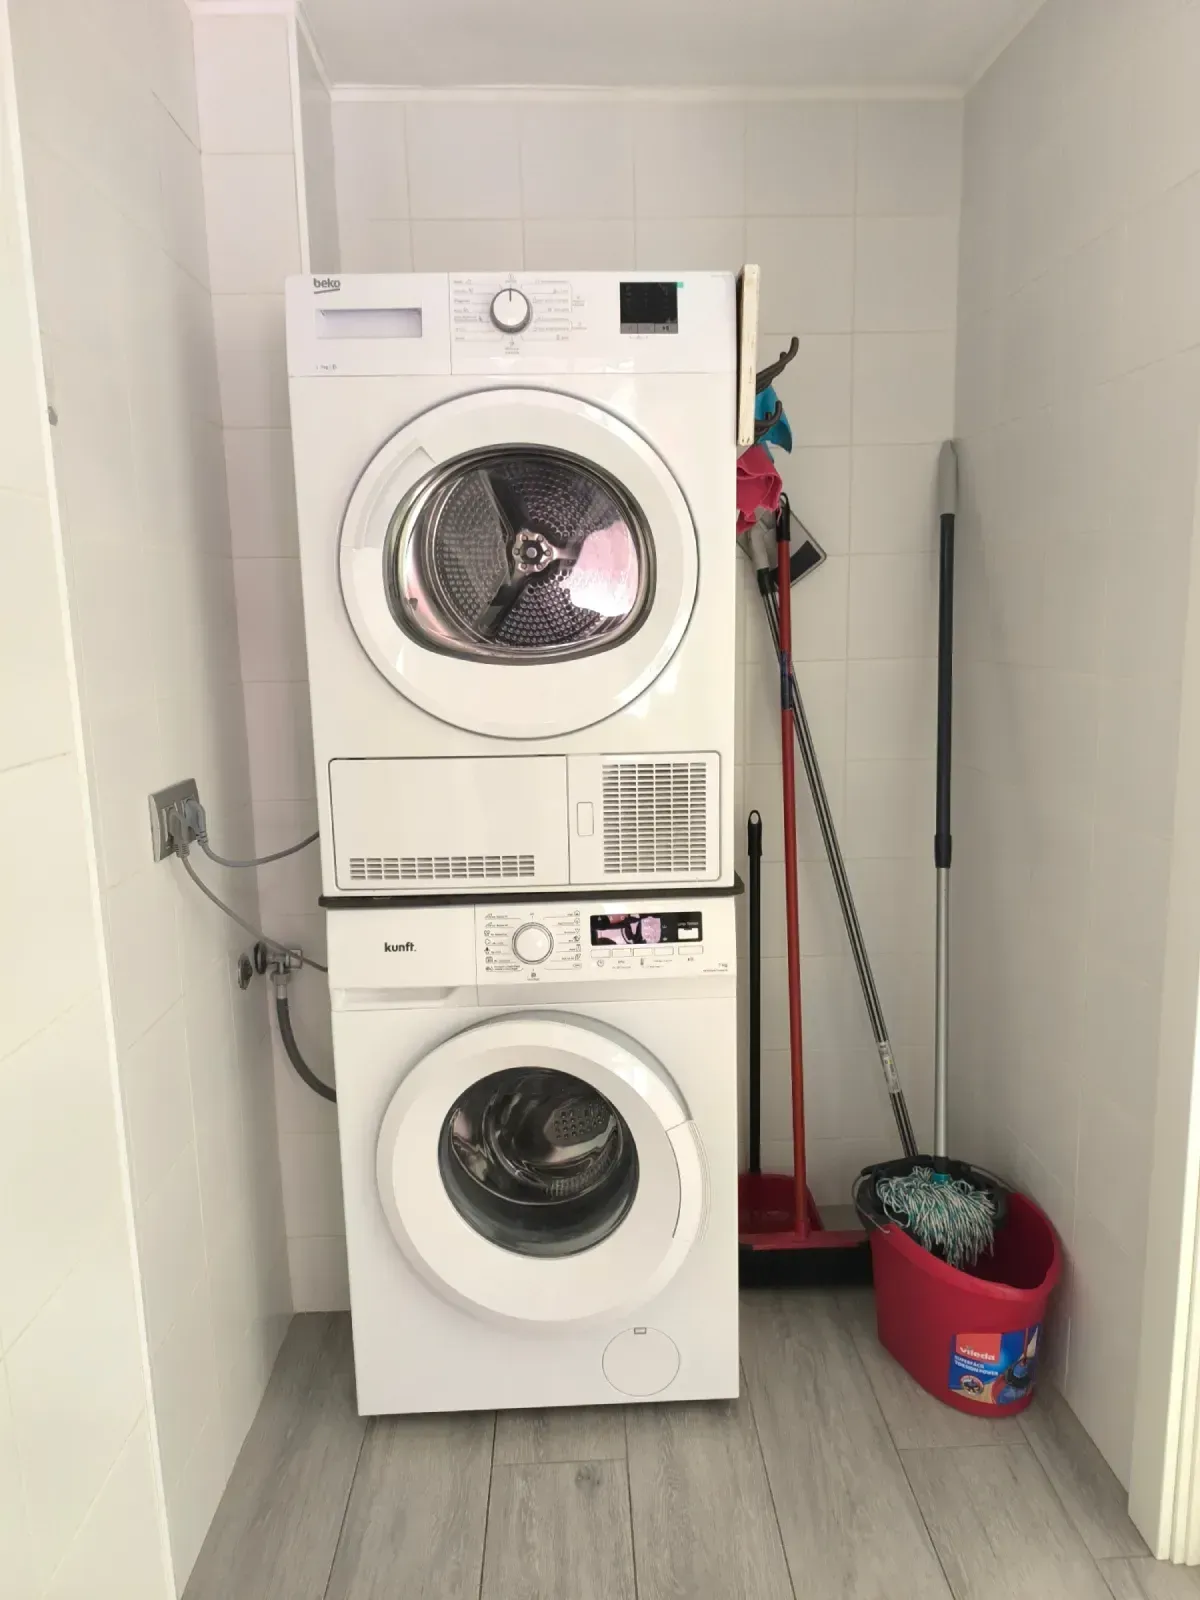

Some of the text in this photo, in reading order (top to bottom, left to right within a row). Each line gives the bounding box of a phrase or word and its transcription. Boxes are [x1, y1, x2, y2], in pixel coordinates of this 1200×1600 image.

[313, 277, 341, 289] beko
[384, 941, 417, 953] kunft.
[960, 1346, 995, 1360] vileda
